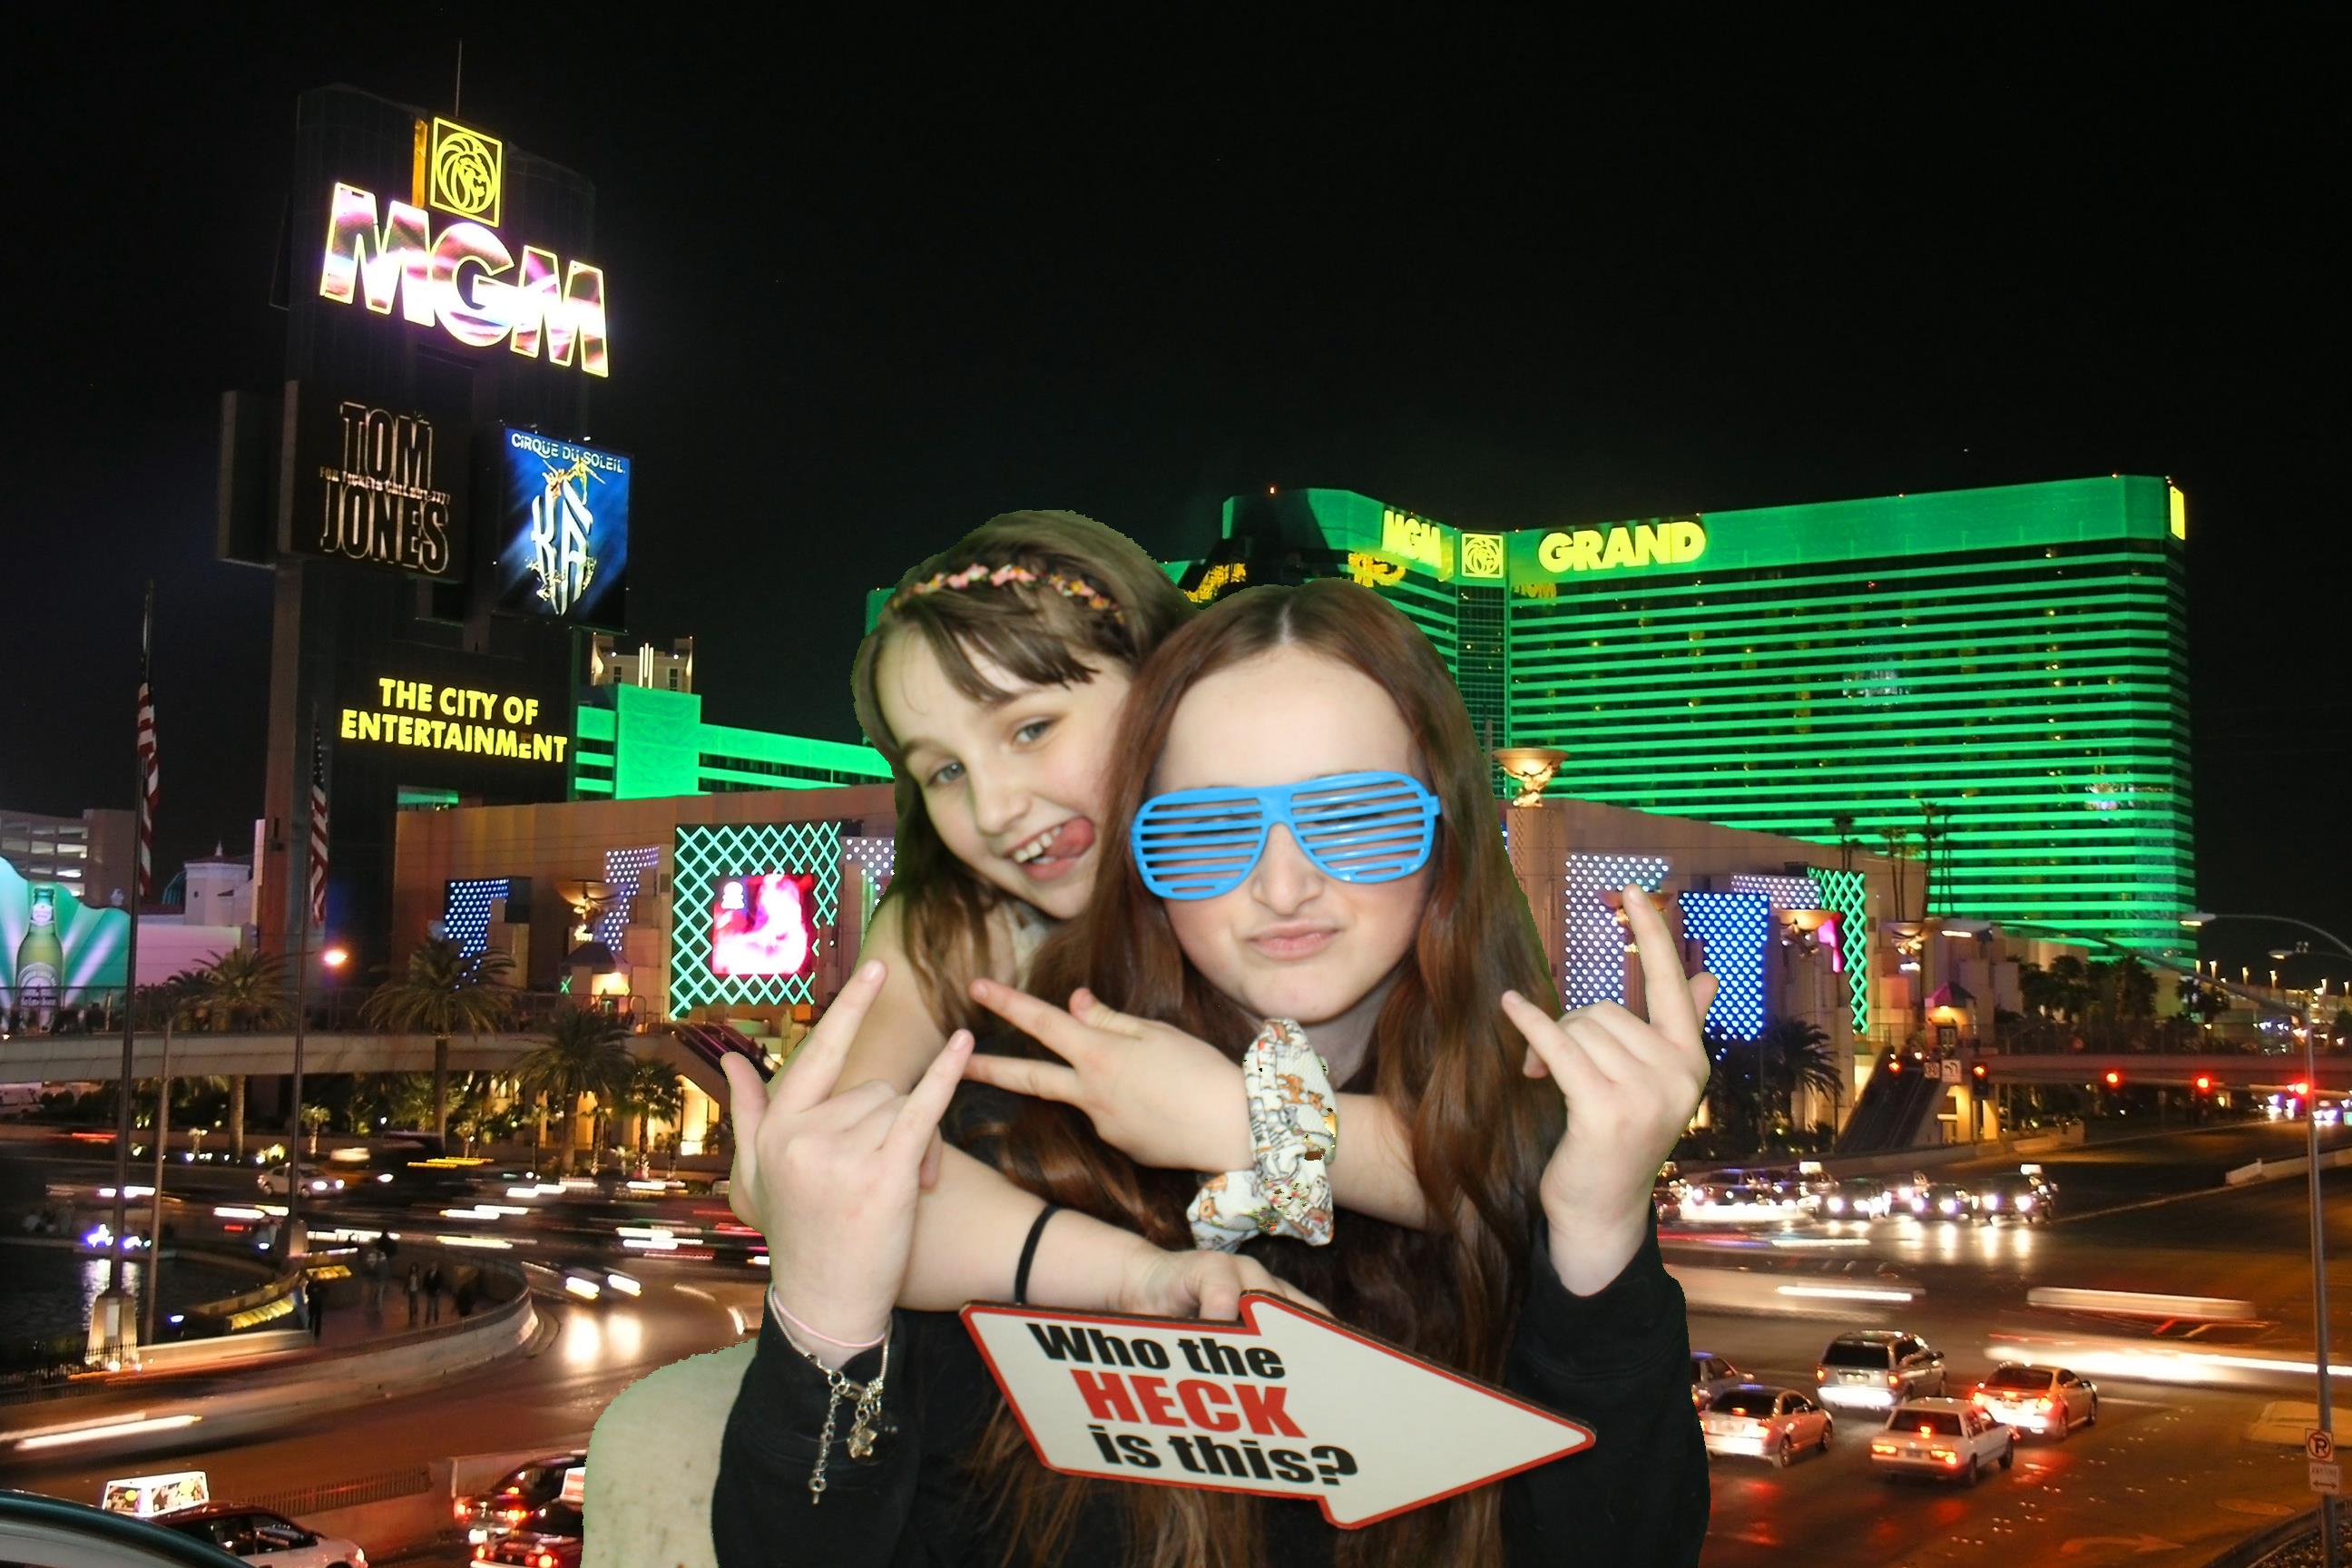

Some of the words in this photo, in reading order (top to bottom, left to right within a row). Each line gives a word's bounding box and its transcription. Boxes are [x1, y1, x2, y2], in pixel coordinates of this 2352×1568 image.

[319, 181, 609, 377] MGM
[339, 401, 433, 490] TOM
[511, 433, 559, 458] CIRQUE
[562, 446, 580, 460] DU
[320, 481, 449, 573] JONES
[1381, 510, 1442, 569] MGM
[1538, 521, 1706, 573] GRAND
[378, 677, 433, 711] THE
[439, 687, 498, 720] CITY
[503, 696, 539, 726] OF
[340, 709, 568, 763] ENTERTAINMENT
[1025, 1323, 1171, 1371] Who
[1178, 1338, 1286, 1379] the
[1070, 1368, 1308, 1438] HECK
[1087, 1424, 1161, 1469] is
[1168, 1435, 1358, 1486] this?
